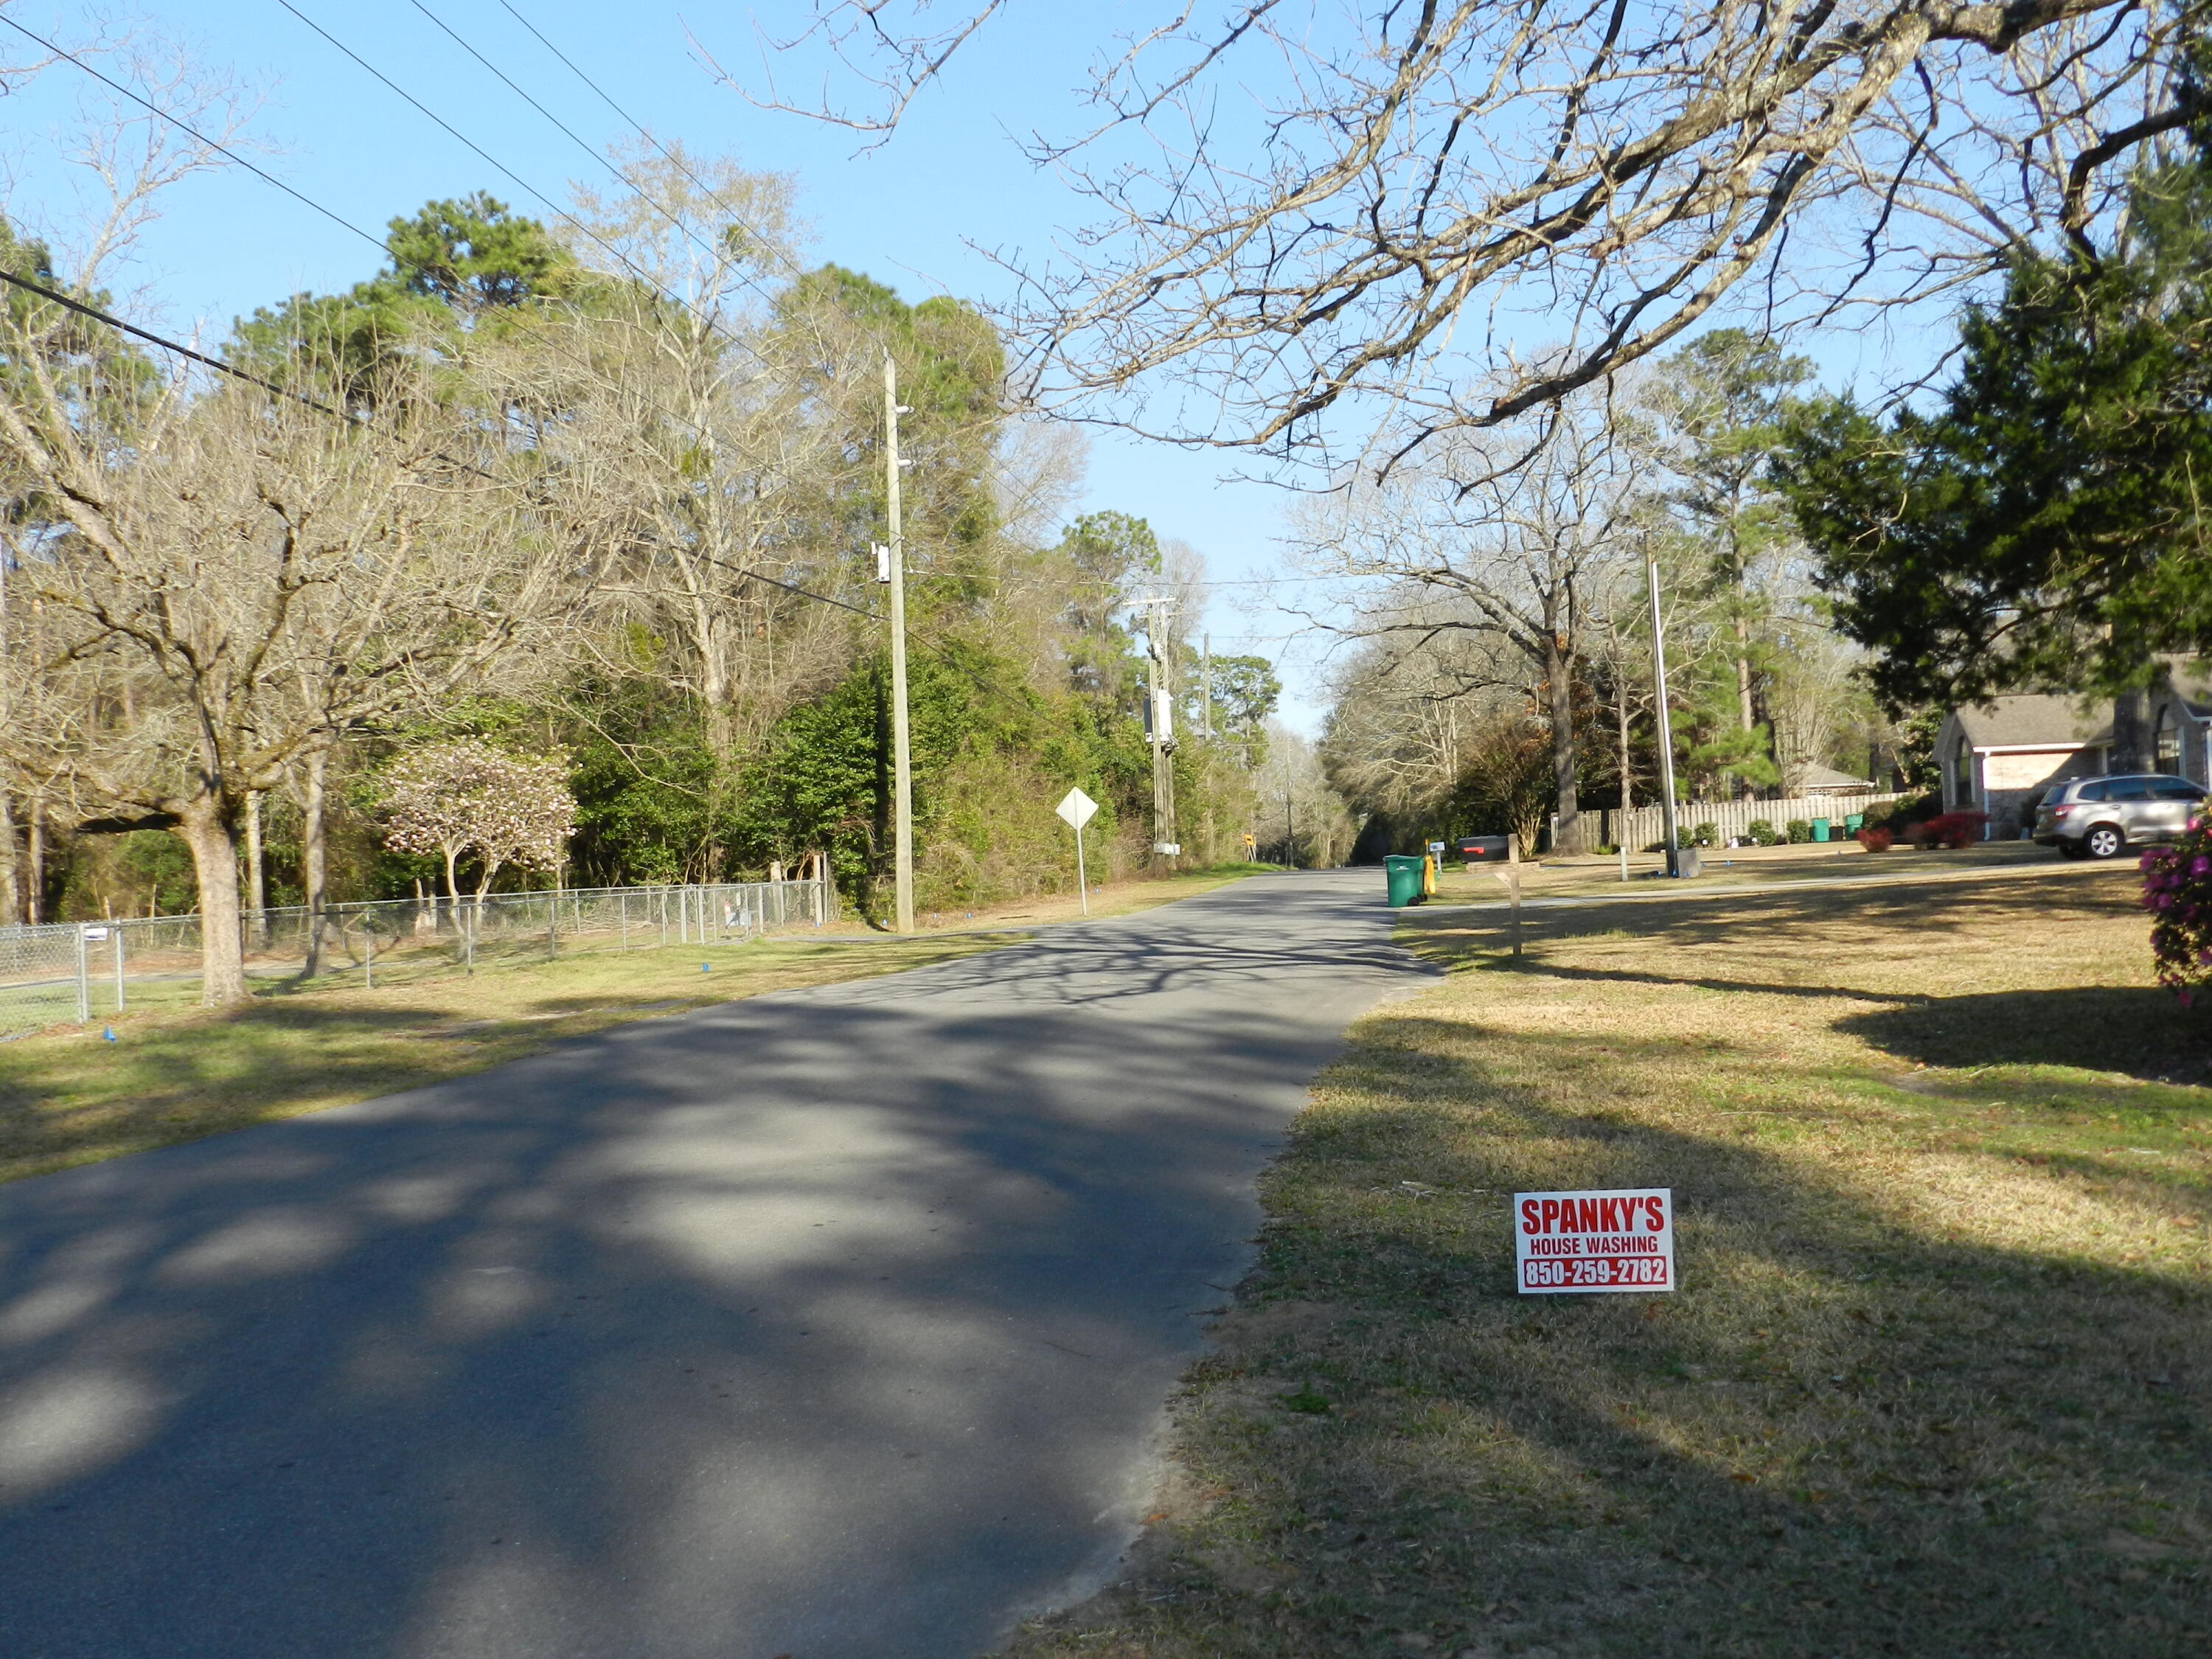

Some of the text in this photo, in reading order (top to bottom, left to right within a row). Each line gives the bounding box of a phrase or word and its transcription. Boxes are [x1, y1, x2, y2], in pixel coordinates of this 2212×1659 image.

[1522, 1197, 1664, 1234] SPANKY'S
[1531, 1236, 1658, 1255] HOUSE WASHING
[1526, 1259, 1665, 1284] 850-259-2782
